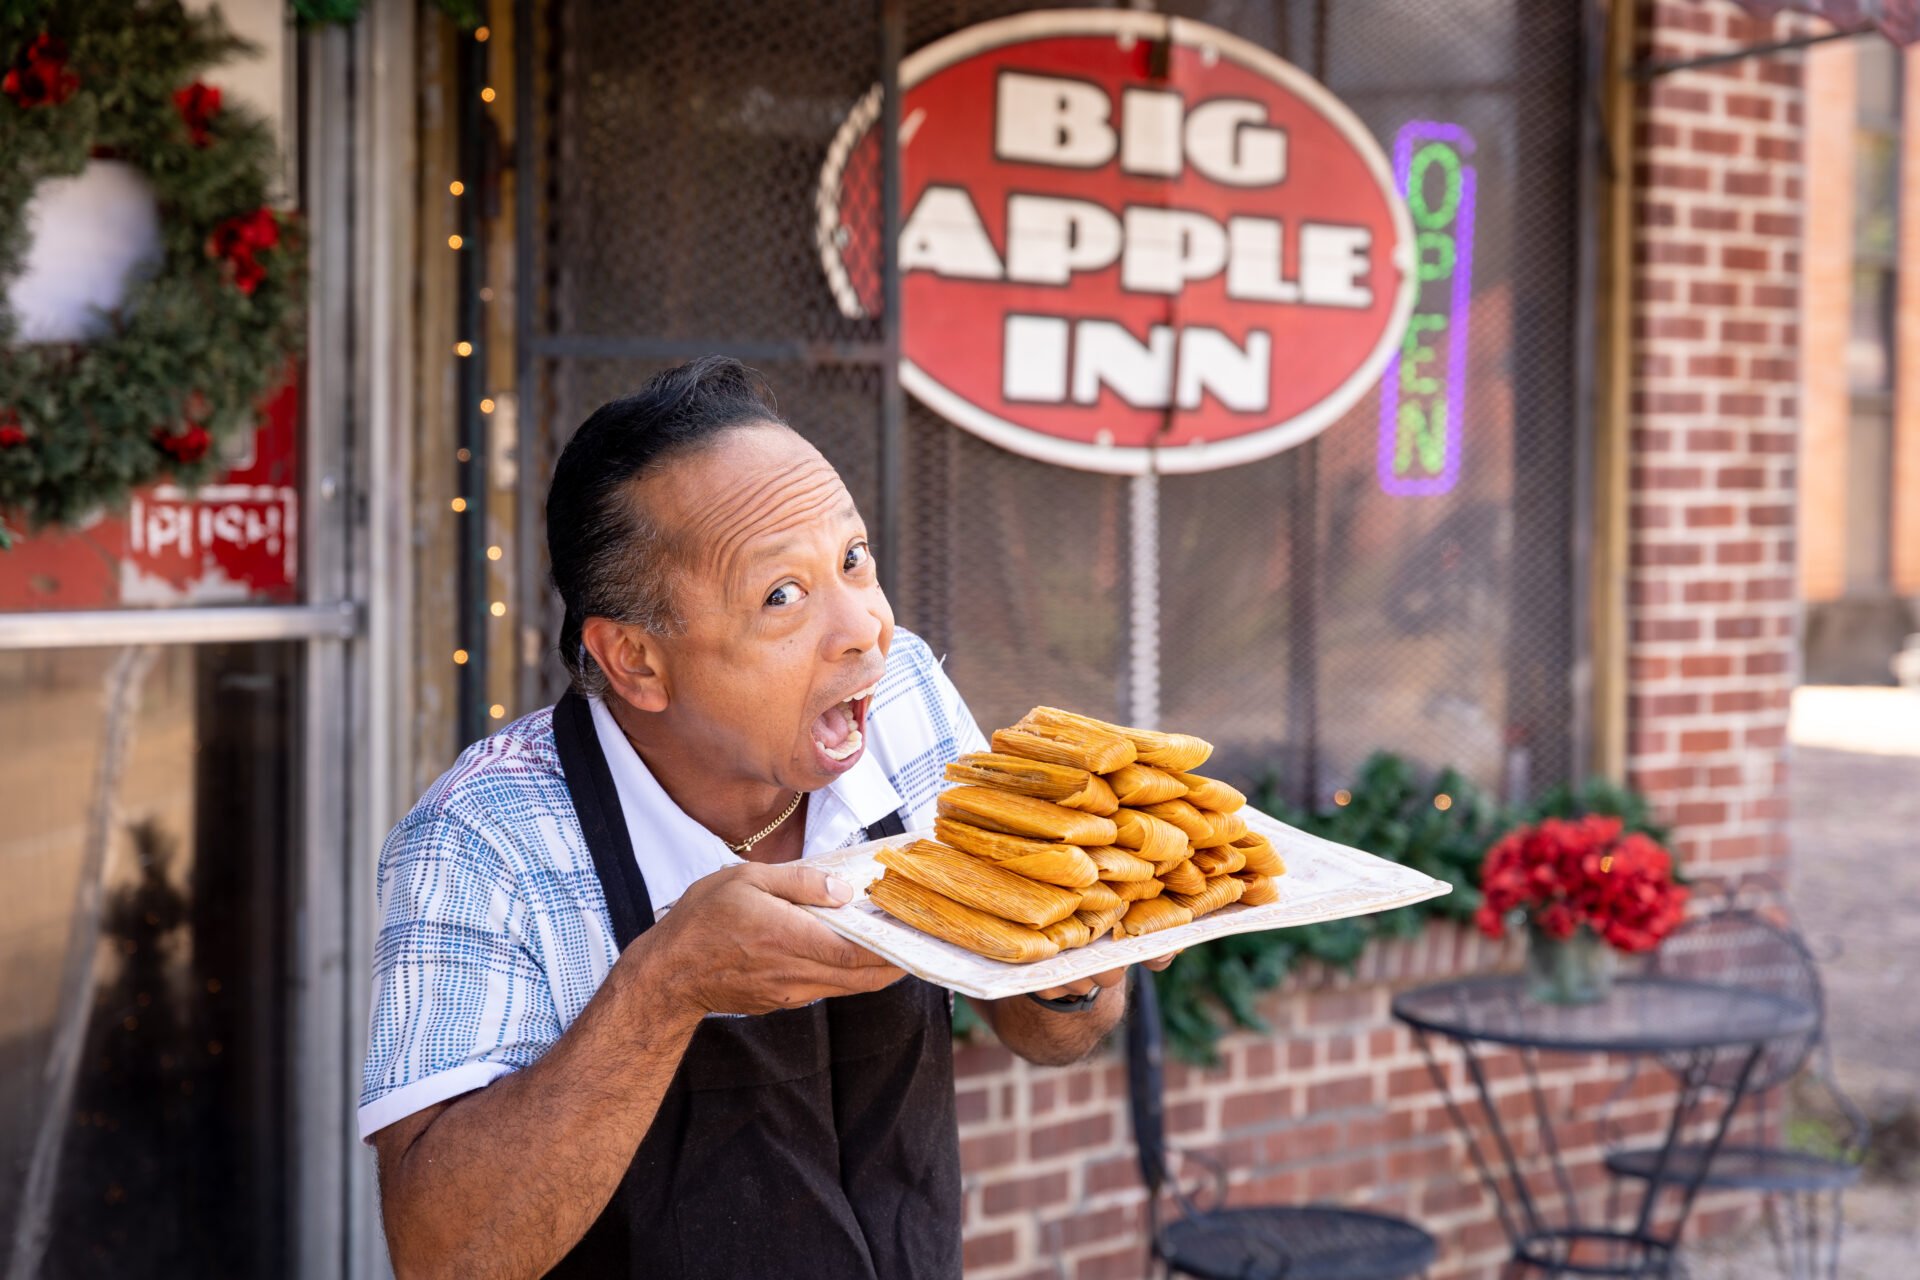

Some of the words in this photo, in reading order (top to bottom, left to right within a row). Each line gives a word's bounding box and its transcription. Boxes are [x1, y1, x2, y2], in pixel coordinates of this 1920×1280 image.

[996, 71, 1288, 187] BIG
[899, 186, 1373, 308] APPLE
[1004, 314, 1271, 412] INN
[1393, 142, 1463, 475] OPEN
